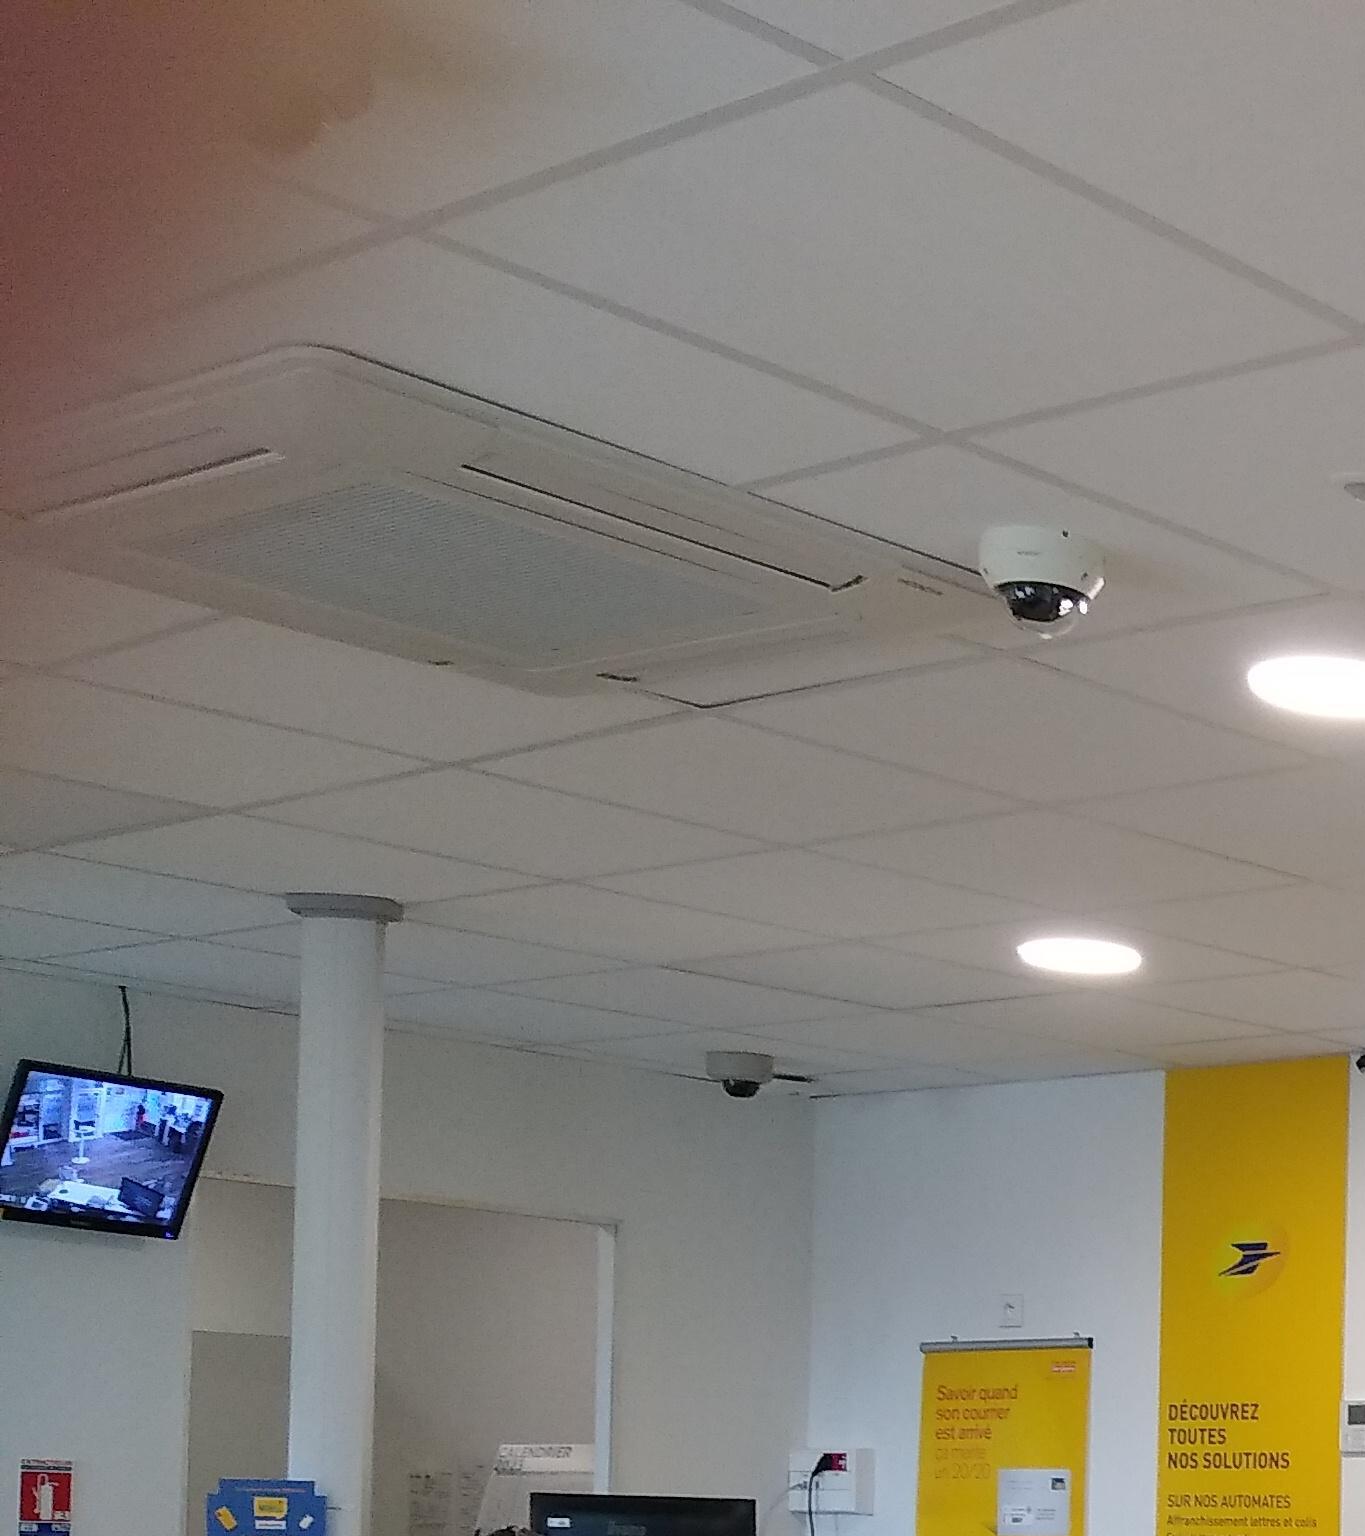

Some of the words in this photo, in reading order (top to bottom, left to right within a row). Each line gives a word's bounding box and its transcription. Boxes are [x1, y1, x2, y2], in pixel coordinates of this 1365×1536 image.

[936, 1384, 977, 1401] Savoir
[979, 1384, 1018, 1404] quand
[936, 1407, 960, 1420] son
[1168, 1399, 1260, 1421] DÉCOUVREZ
[936, 1427, 955, 1440] est
[1168, 1428, 1227, 1445] TOUTES
[1168, 1452, 1198, 1469] NOS
[1203, 1452, 1290, 1470] SOLUTIONS
[1167, 1494, 1191, 1508] SUR
[1194, 1494, 1218, 1508] NOS
[1220, 1494, 1291, 1509] AUTOMATES
